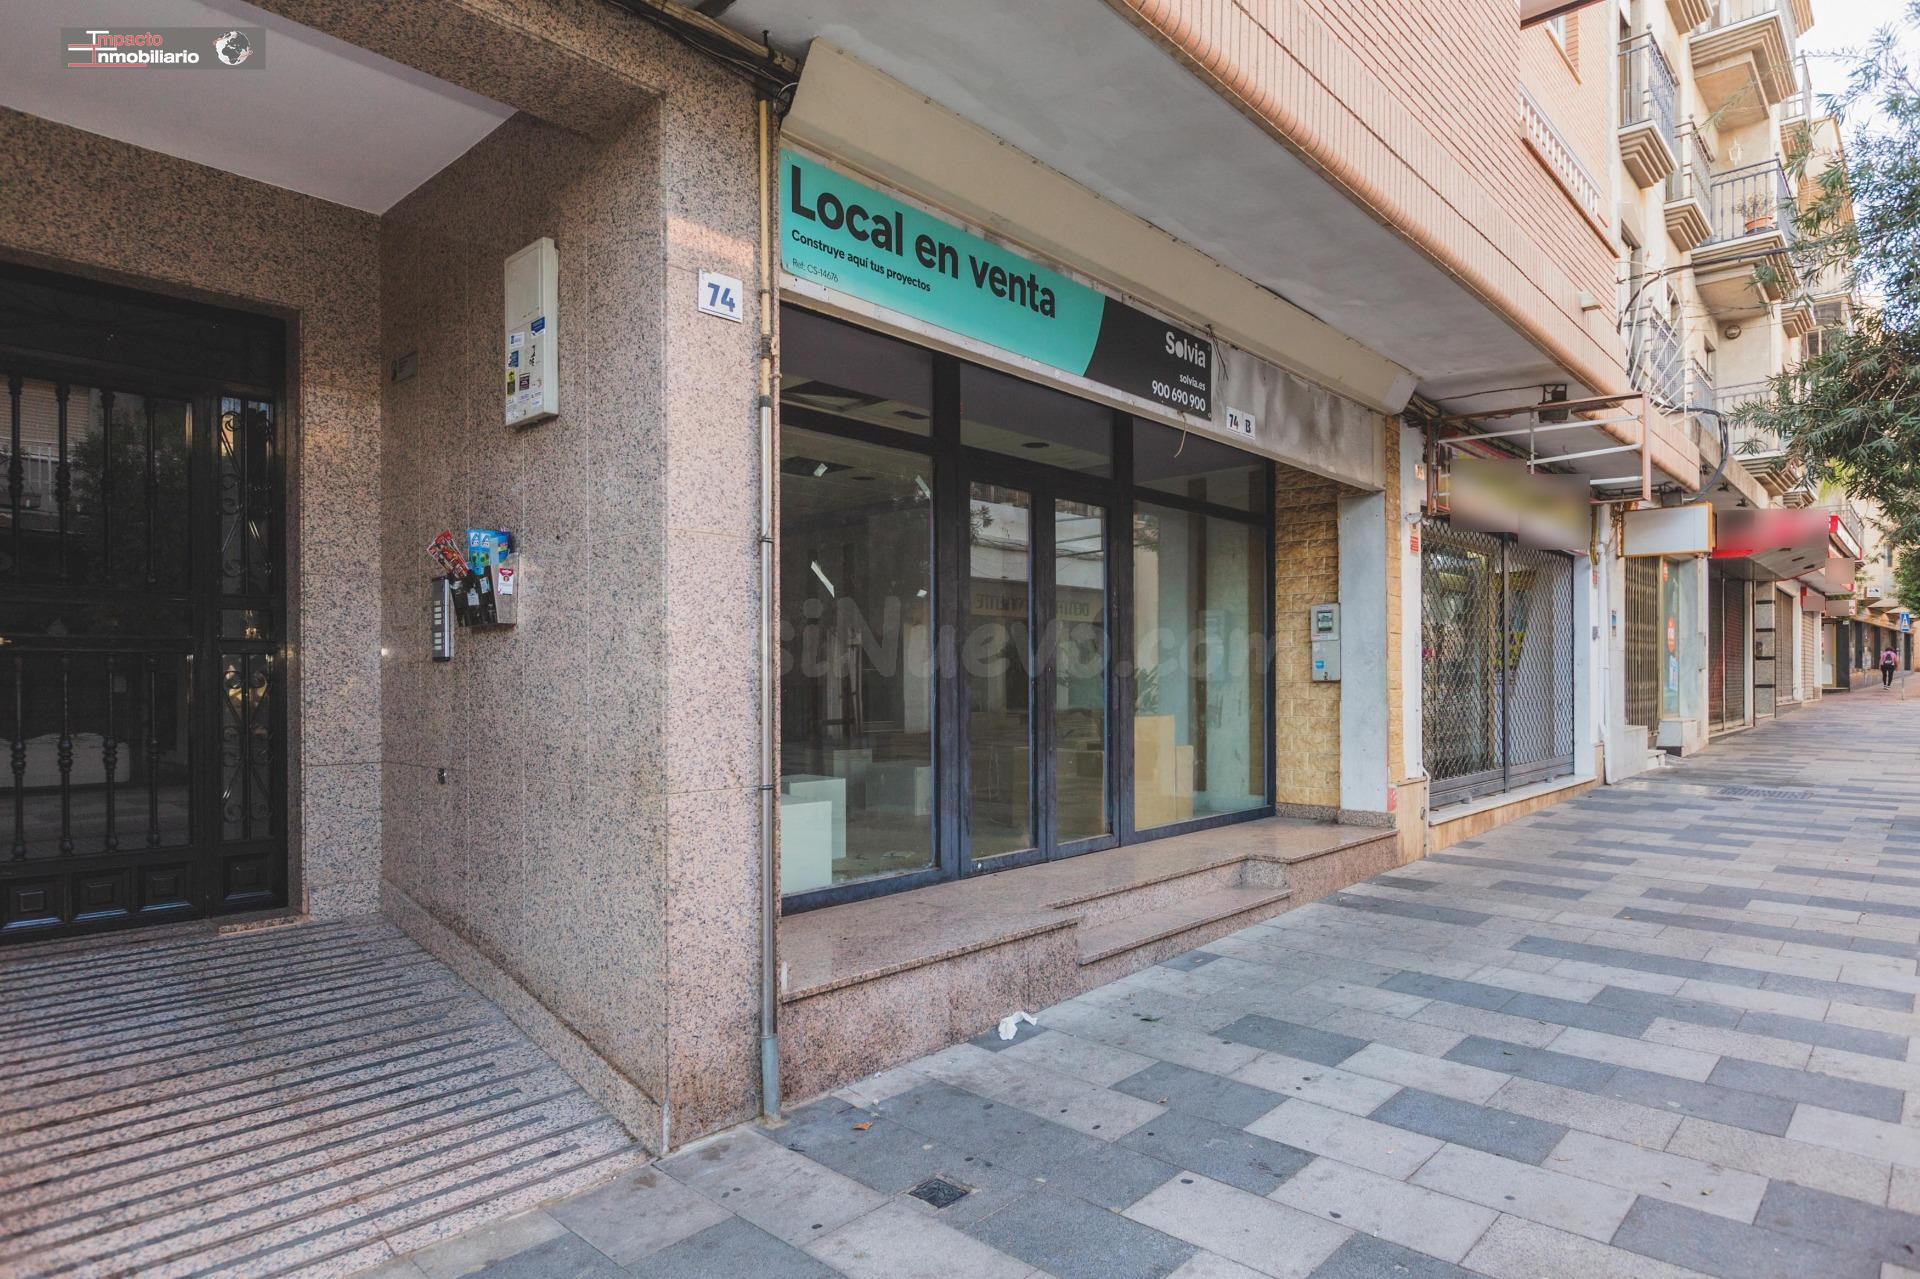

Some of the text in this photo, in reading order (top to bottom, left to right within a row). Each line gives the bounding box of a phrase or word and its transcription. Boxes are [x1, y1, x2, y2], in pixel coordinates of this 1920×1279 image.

[791, 165, 1056, 319] Local en venta
[791, 229, 931, 292] Construye aquí tus proyectos
[707, 282, 736, 312] 74
[1166, 331, 1206, 368] Solvia
[1152, 380, 1206, 412] 900 690 900
[1180, 374, 1206, 391] solvia.es
[1229, 414, 1251, 433] 74 B
